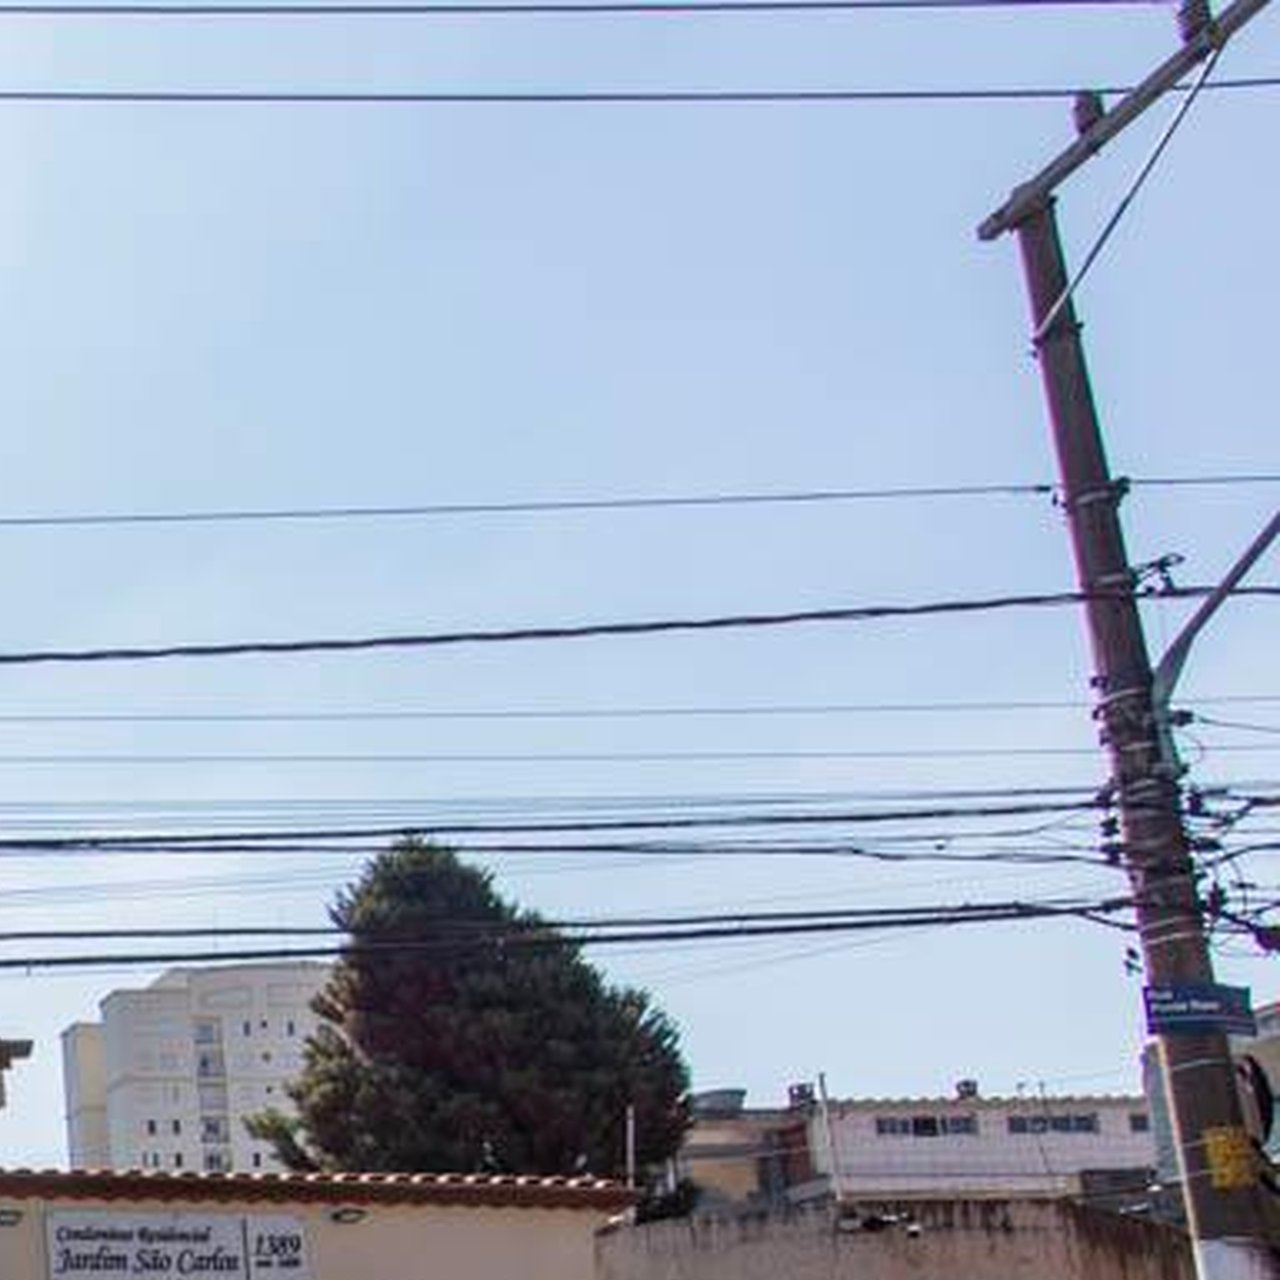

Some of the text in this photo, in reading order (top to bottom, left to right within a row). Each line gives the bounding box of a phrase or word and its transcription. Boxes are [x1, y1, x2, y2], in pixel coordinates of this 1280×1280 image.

[254, 1233, 302, 1257] 1389
[54, 1246, 240, 1275] Jardim São Carlos
